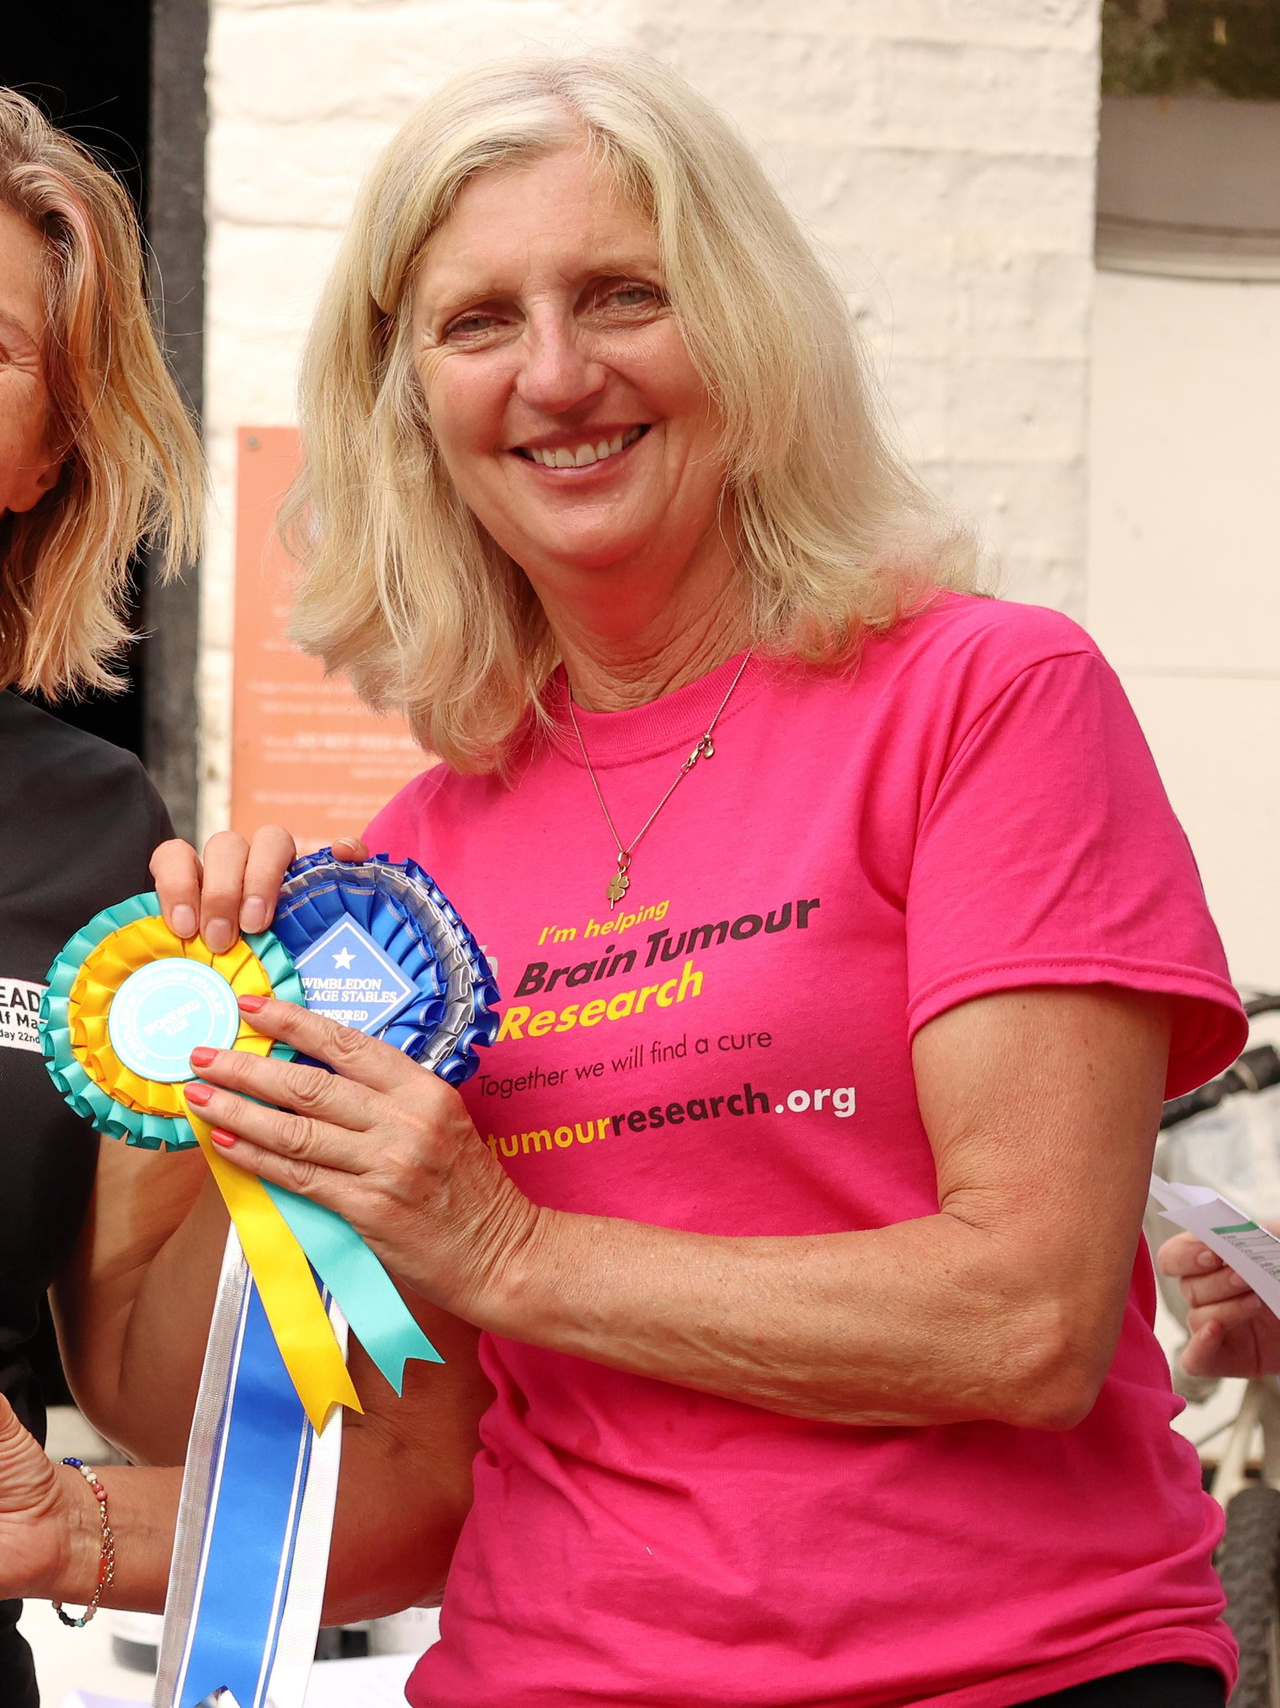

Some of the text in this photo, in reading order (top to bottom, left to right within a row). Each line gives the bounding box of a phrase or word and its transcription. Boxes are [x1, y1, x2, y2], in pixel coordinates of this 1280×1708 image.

[513, 898, 821, 998] Brain Tumour
[537, 900, 670, 946] I'm helping
[301, 977, 382, 991] WIMBLEDON
[304, 990, 398, 1003] LAGE STABLES
[496, 960, 704, 1043] Research
[16, 1013, 45, 1030] Ma
[477, 1031, 772, 1099] Together we will find a cure
[487, 1083, 857, 1159] tumourresearch.org
